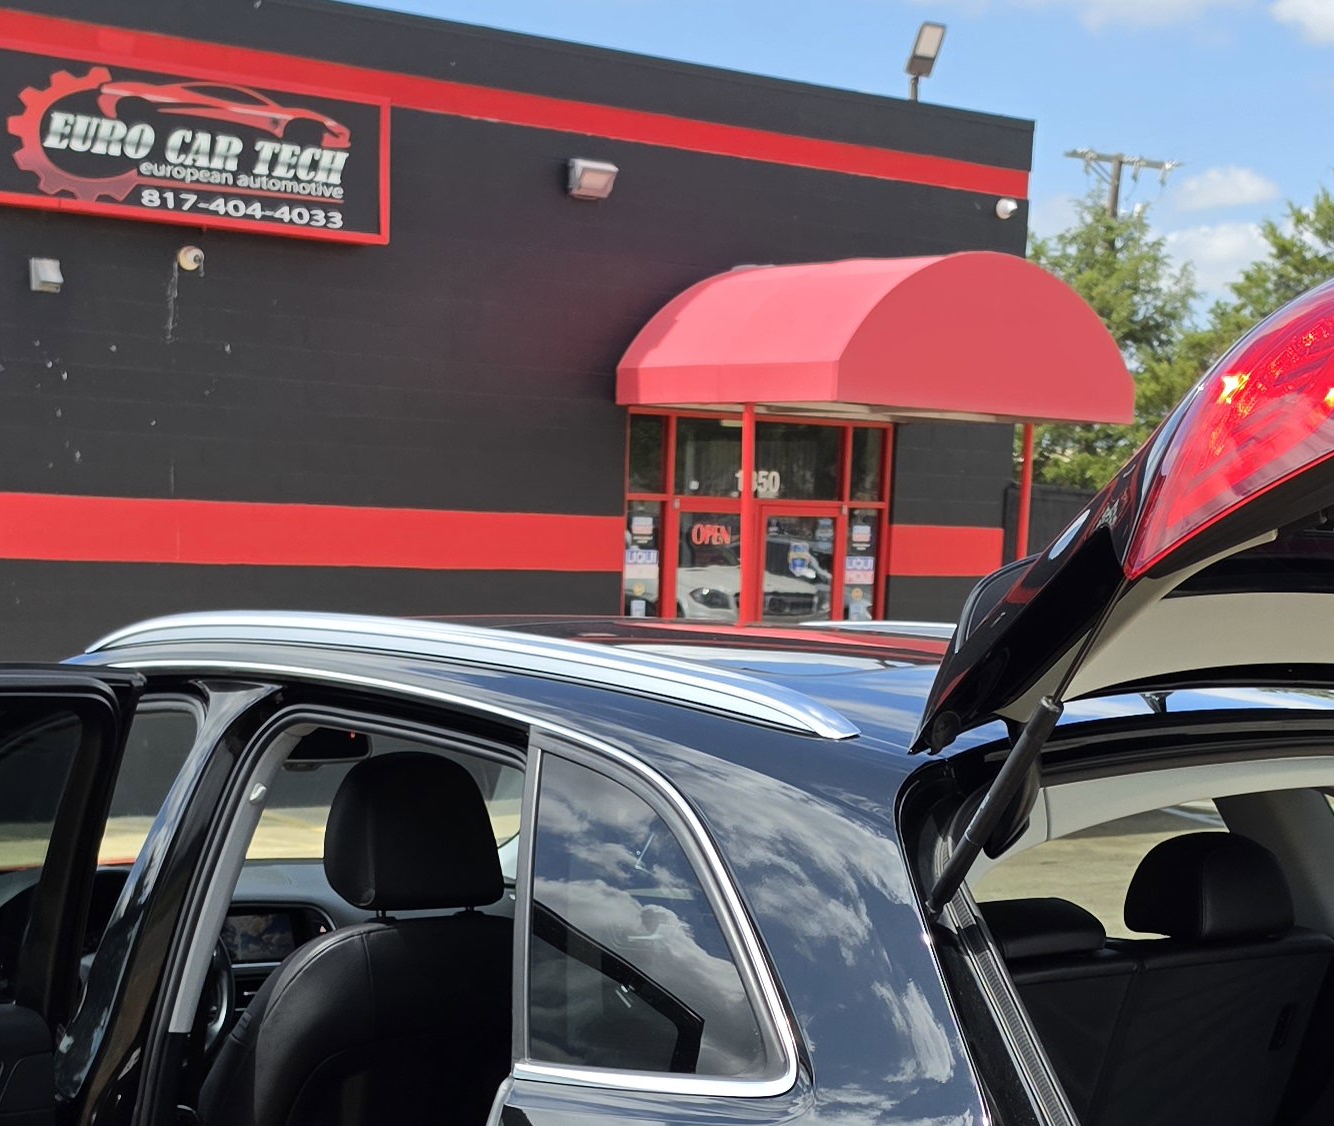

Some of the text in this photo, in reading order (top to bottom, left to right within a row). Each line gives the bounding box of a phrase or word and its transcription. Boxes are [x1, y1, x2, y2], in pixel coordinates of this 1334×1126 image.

[43, 110, 350, 185] EURO CAR TECH
[140, 161, 344, 200] european automotive
[140, 188, 345, 229] 817-404-4033
[691, 524, 731, 545] OPEN
